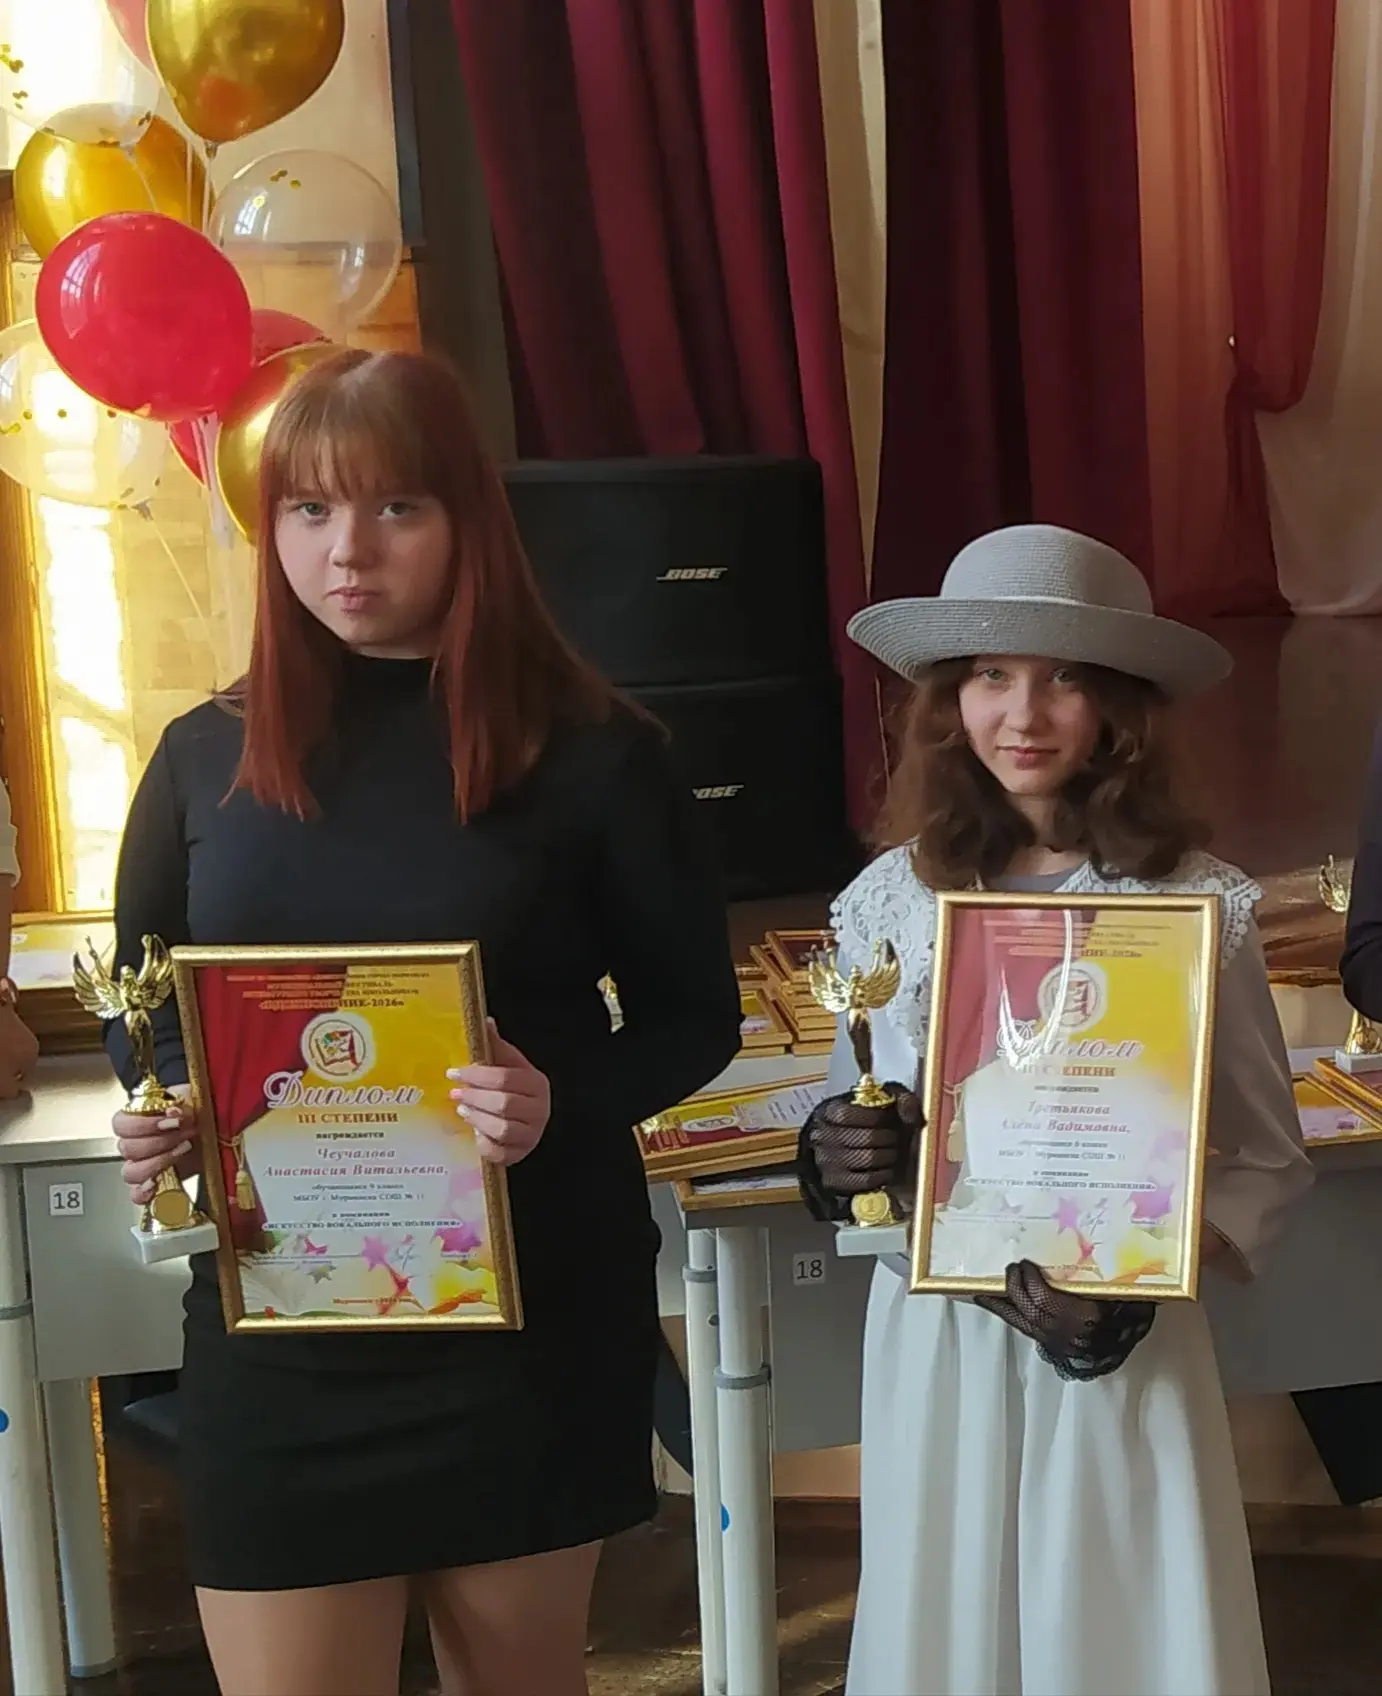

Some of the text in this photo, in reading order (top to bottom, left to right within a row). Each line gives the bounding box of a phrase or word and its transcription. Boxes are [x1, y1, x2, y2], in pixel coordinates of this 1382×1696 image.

[661, 567, 726, 581] BOSE
[692, 784, 744, 800] OSE
[264, 1071, 424, 1108] Диплом
[298, 1112, 398, 1124] III СТЕПЕНИ
[317, 1147, 396, 1162] Чеучалова
[263, 1164, 449, 1177] Анастасия Витальевна,
[53, 1190, 80, 1210] 18
[797, 1259, 823, 1280] 18
